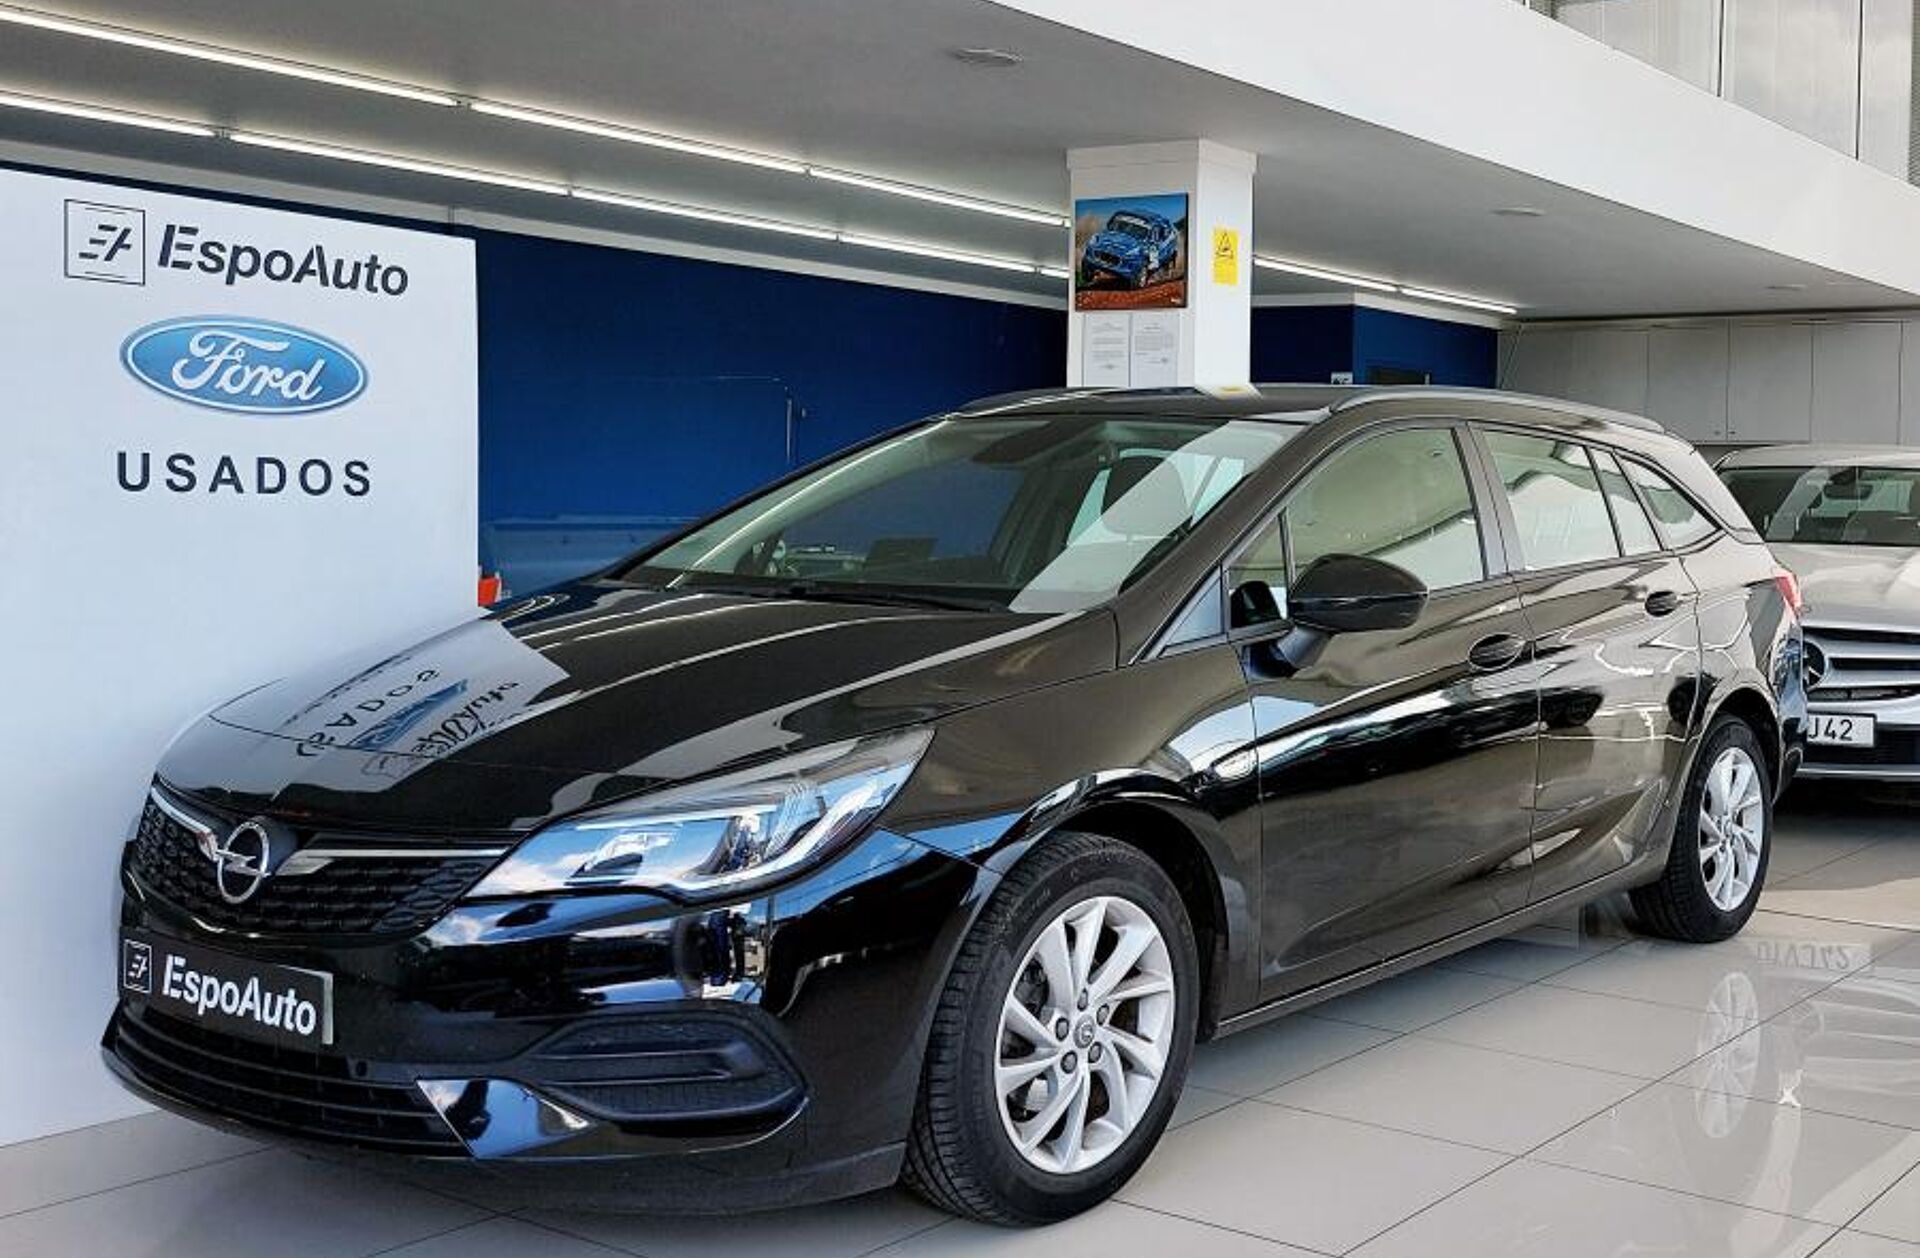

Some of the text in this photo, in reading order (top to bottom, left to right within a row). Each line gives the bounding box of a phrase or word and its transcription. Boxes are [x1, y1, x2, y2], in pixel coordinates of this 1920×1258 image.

[157, 224, 409, 296] EspoAuto
[171, 330, 325, 401] Ford
[116, 451, 371, 497] USADOS
[162, 954, 317, 1035] EspoAuto
